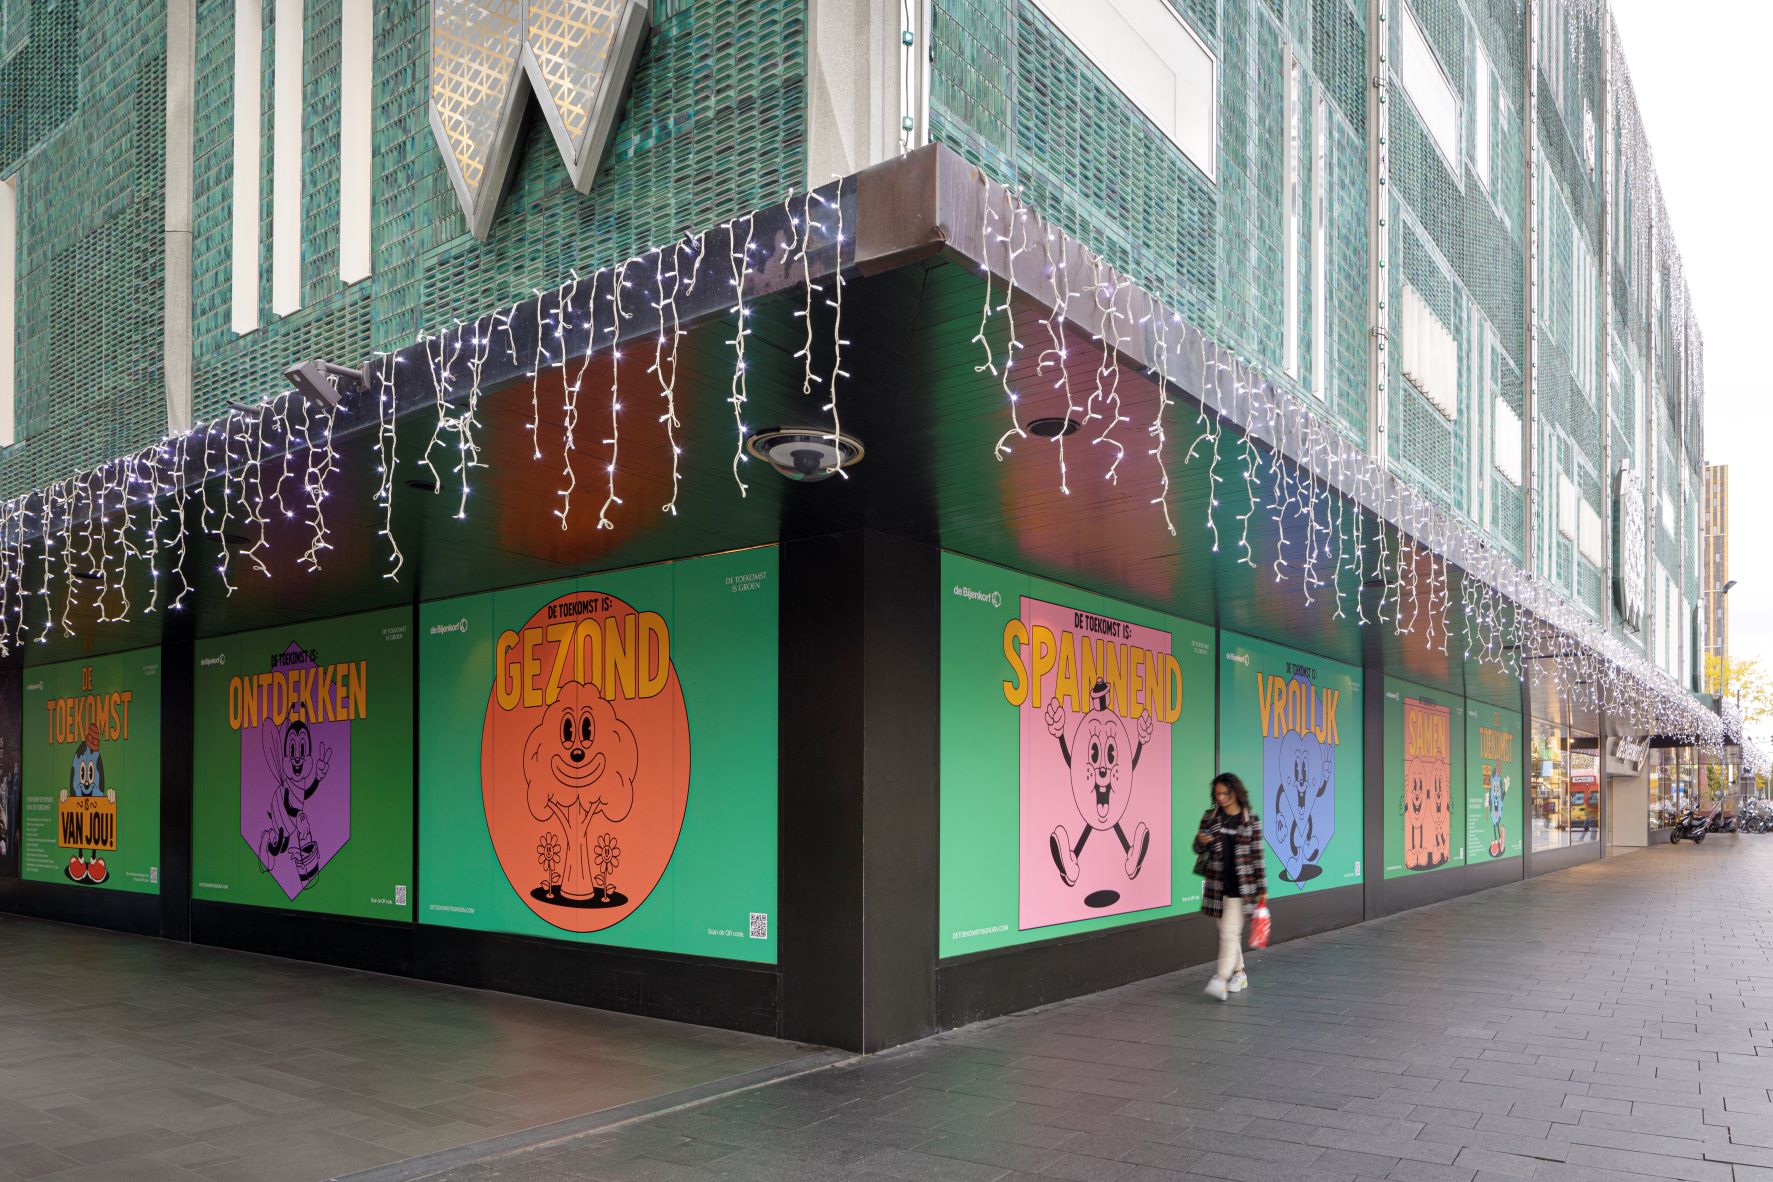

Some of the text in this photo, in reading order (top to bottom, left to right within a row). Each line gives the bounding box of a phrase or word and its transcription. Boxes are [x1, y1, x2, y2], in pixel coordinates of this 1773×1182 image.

[548, 597, 613, 619] DE TOEKOMST IS:
[953, 585, 991, 603] de Bijenkorf
[1074, 612, 1132, 640] DE TOEKOMST IS:
[279, 649, 308, 666] TOEKOMST
[496, 611, 671, 711] GEZOND
[1002, 618, 1183, 724] SPANNEND
[82, 665, 93, 691] DE
[229, 659, 367, 730] ONTDEKKEN
[47, 690, 133, 744] TOEKOMST
[1257, 671, 1340, 746] VROLIJK
[1408, 709, 1447, 758] SAMEN
[1479, 727, 1513, 762] TOEKOMST
[61, 811, 83, 845] VAN
[85, 811, 114, 848] JOU!
